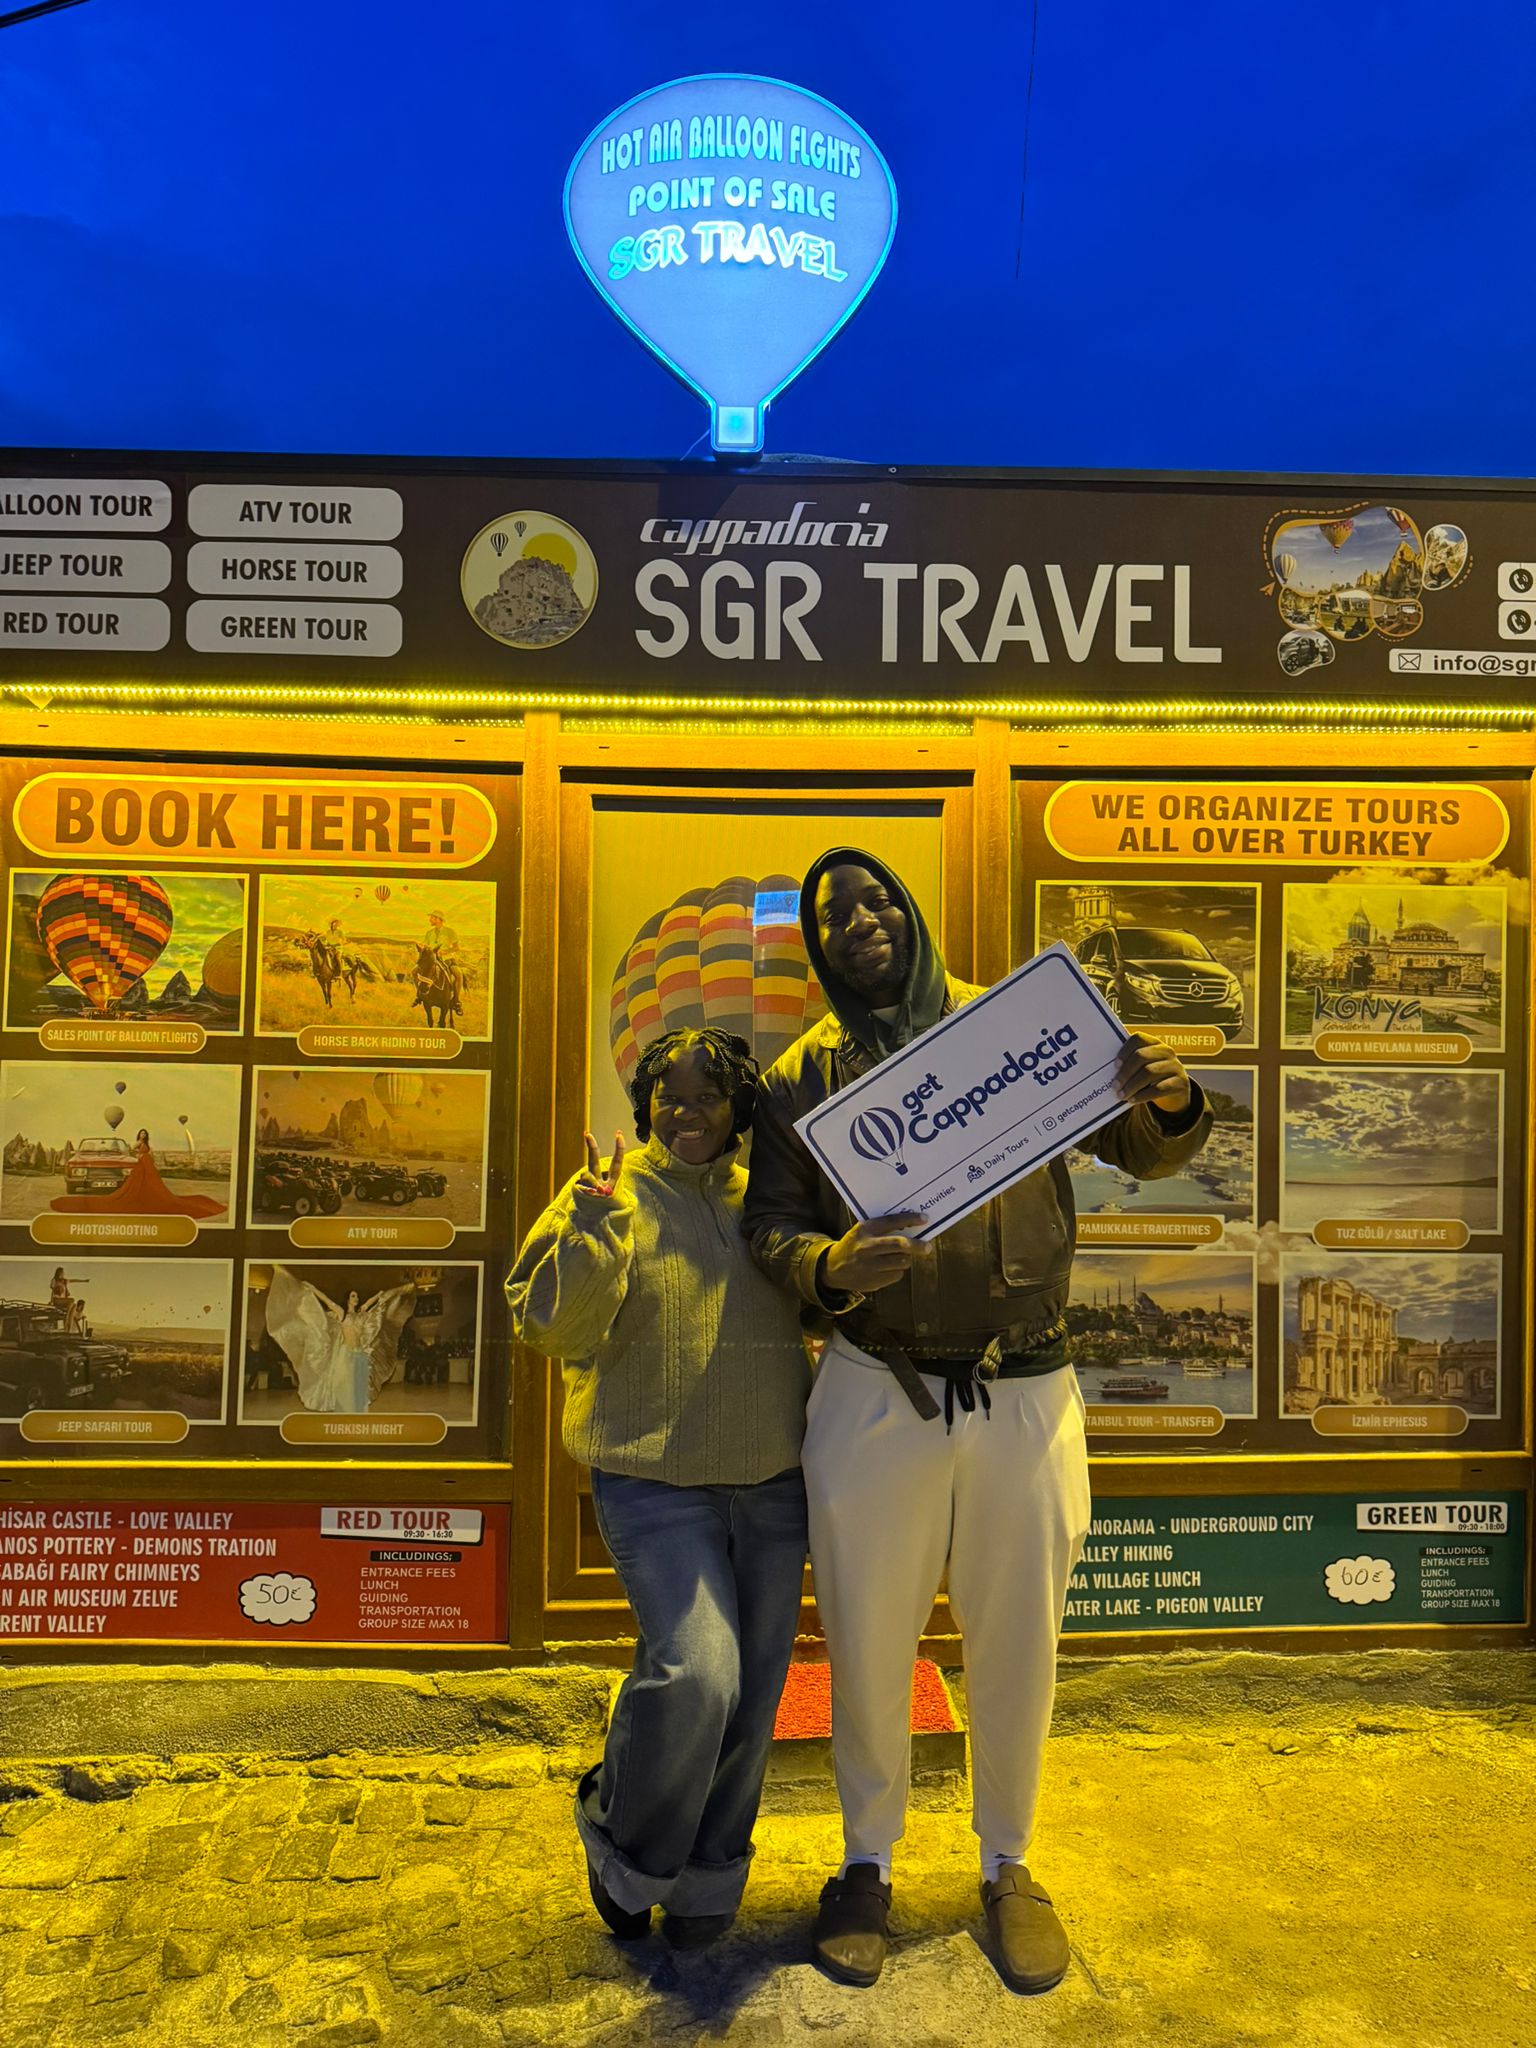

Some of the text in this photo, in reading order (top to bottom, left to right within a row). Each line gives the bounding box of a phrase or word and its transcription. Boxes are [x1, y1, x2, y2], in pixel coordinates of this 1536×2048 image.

[602, 115, 861, 179] HOT AIR BALLOON FLGHTS
[629, 176, 836, 221] POINT OF SALE
[608, 221, 848, 282] SGR TRAVEL
[0, 494, 153, 517] LLOON TOUR
[239, 500, 352, 524] ATV TOUR
[639, 501, 890, 556] cappadocia
[1, 553, 123, 577] JEEP TOUR
[222, 558, 367, 583] HORSE TOUR
[635, 558, 1222, 663] SGR TRAVEL
[3, 612, 119, 635] RED TOUR
[221, 616, 367, 641] GREEN TOUR
[1091, 794, 1460, 825] WE ORGANIZE TOURS
[55, 787, 456, 854] BOOK HERE!
[1117, 827, 1433, 857] ALL OVER TURKEY
[47, 1030, 199, 1044] SALES POINT OF BALLOON FLIGHTS
[314, 1035, 446, 1049] HORSE BACK RIDING TOUR
[1164, 1035, 1216, 1047] TRANSFER
[1328, 1041, 1458, 1054] KONYA MEVLANA MUSEUM
[1033, 1049, 1078, 1086] tour
[908, 1024, 1078, 1144] Cappadocia
[902, 1073, 944, 1116] get
[983, 1136, 1029, 1169] Daily Tours
[920, 1185, 956, 1212] Activities
[70, 1224, 158, 1236] PHOTOSHOOTING
[347, 1227, 398, 1239] ATV TOUR
[1078, 1223, 1211, 1236] PAMUKKALE TRAVERTINES
[1336, 1228, 1356, 1239] TUZ
[1394, 1228, 1420, 1239] SALT
[1421, 1228, 1447, 1240] LAKE
[56, 1421, 152, 1433] JEEP SAFARI TOUR
[324, 1423, 404, 1435] TURKISH NIGHT
[1086, 1415, 1124, 1427] TANBUL
[1126, 1415, 1153, 1427] TOUR
[1162, 1416, 1215, 1427] TRANSFER
[1383, 1416, 1428, 1428] EPHESUS
[52, 1510, 112, 1529] CASTLE
[130, 1511, 168, 1530] LOVE
[174, 1512, 233, 1530] VALLEY
[337, 1510, 451, 1530] RED TOUR
[1367, 1504, 1503, 1525] GREEN TOUR
[1170, 1516, 1278, 1534] UNDERGROUND
[1282, 1515, 1314, 1532] CITY
[1458, 1523, 1478, 1531] 09:30
[1485, 1523, 1505, 1531] 18:00
[403, 1530, 425, 1538] 09:30
[432, 1530, 453, 1539] 16:30
[0, 1537, 37, 1555] NOS
[43, 1536, 116, 1555] POTTERY
[133, 1537, 203, 1556] DEMONS
[208, 1538, 277, 1557] TRATION
[1124, 1545, 1173, 1562] HIKING
[0, 1558, 200, 1582] ABAĞI FAIRY CHIMNEYS
[1421, 1557, 1490, 1567] ENTRANCE FEES
[360, 1567, 456, 1578] ENTRANCE FEES
[1093, 1572, 1149, 1590] VILLAGE
[1155, 1571, 1200, 1588] LUNCH
[1421, 1568, 1449, 1577] LUNCH
[360, 1580, 399, 1590] LUNCH
[1421, 1579, 1456, 1588] GUIDING
[18, 1588, 48, 1607] AIR
[54, 1588, 126, 1607] MUSEUM
[132, 1589, 178, 1608] ZELVE
[359, 1593, 409, 1603] GUIDING
[1421, 1589, 1494, 1598] TRANSPORTATION
[359, 1605, 461, 1616] TRANSPORTATION
[1062, 1600, 1101, 1617] ATER
[1105, 1599, 1141, 1616] LAKE
[1156, 1597, 1208, 1615] PIGEON
[1213, 1596, 1263, 1613] VALLEY
[1421, 1599, 1500, 1609] GROUP SIZE MAX 18
[0, 1615, 107, 1633] RENT VALLEY
[358, 1618, 469, 1629] GROUP SIZE MAX 18
